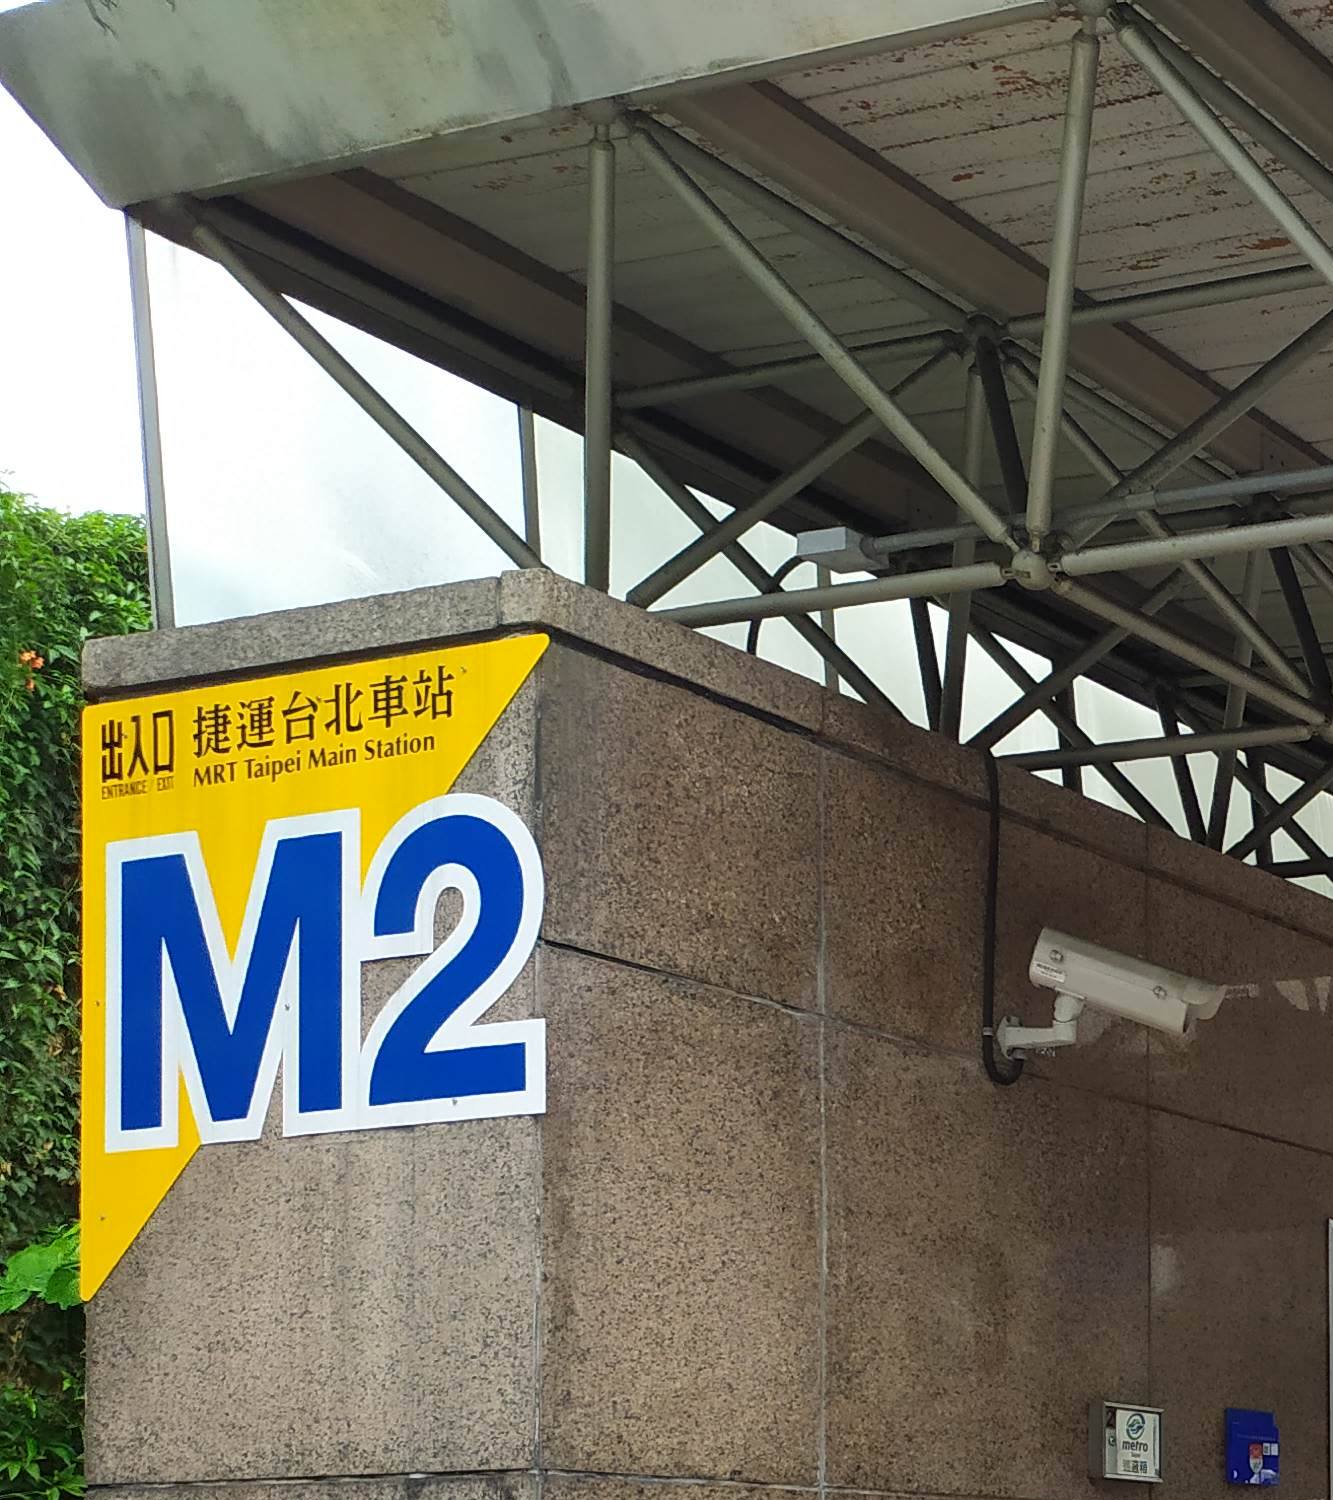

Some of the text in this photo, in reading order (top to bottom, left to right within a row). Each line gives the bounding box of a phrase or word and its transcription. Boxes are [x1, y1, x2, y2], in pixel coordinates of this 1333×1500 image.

[192, 665, 455, 760] 捷運台北車站
[101, 709, 174, 783] 出入口
[193, 734, 436, 788] MRT Taipei Main Station
[101, 779, 148, 800] ENTRANCE
[156, 776, 175, 793] EXIT
[119, 812, 528, 1133] M2
[1122, 1440, 1149, 1453] metro
